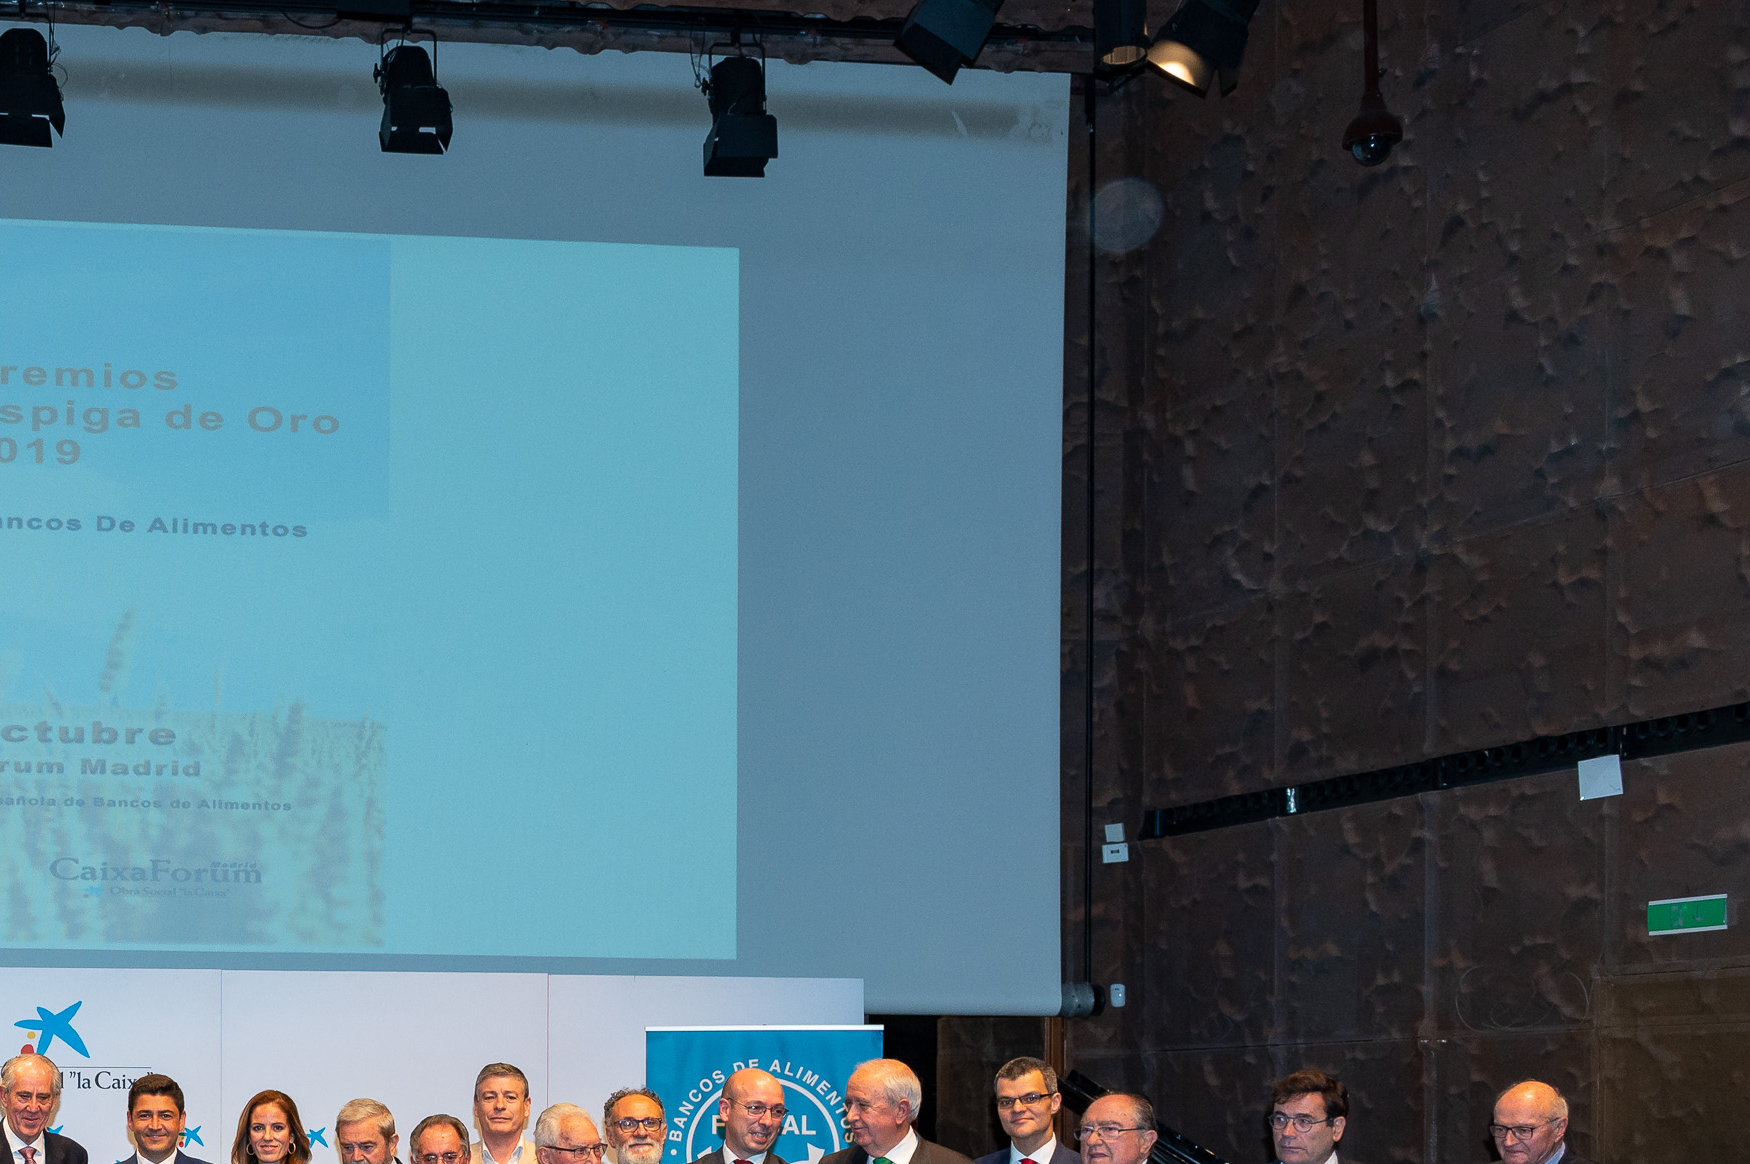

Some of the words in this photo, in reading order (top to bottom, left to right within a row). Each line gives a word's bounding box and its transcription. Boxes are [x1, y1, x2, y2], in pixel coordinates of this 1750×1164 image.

[165, 403, 224, 432] de
[247, 406, 341, 435] Oro
[96, 515, 136, 533] De
[147, 517, 308, 538] Alimentos
[80, 758, 201, 777] Madrid
[63, 796, 86, 807] de
[93, 796, 163, 809] Bancos
[170, 797, 192, 809] de
[197, 799, 293, 812] Alimentos
[49, 857, 263, 884] CaixaForum
[668, 1069, 725, 1142] BANCOS
[768, 1058, 854, 1143] ALIMENTOS
[711, 1114, 817, 1136] FAL
